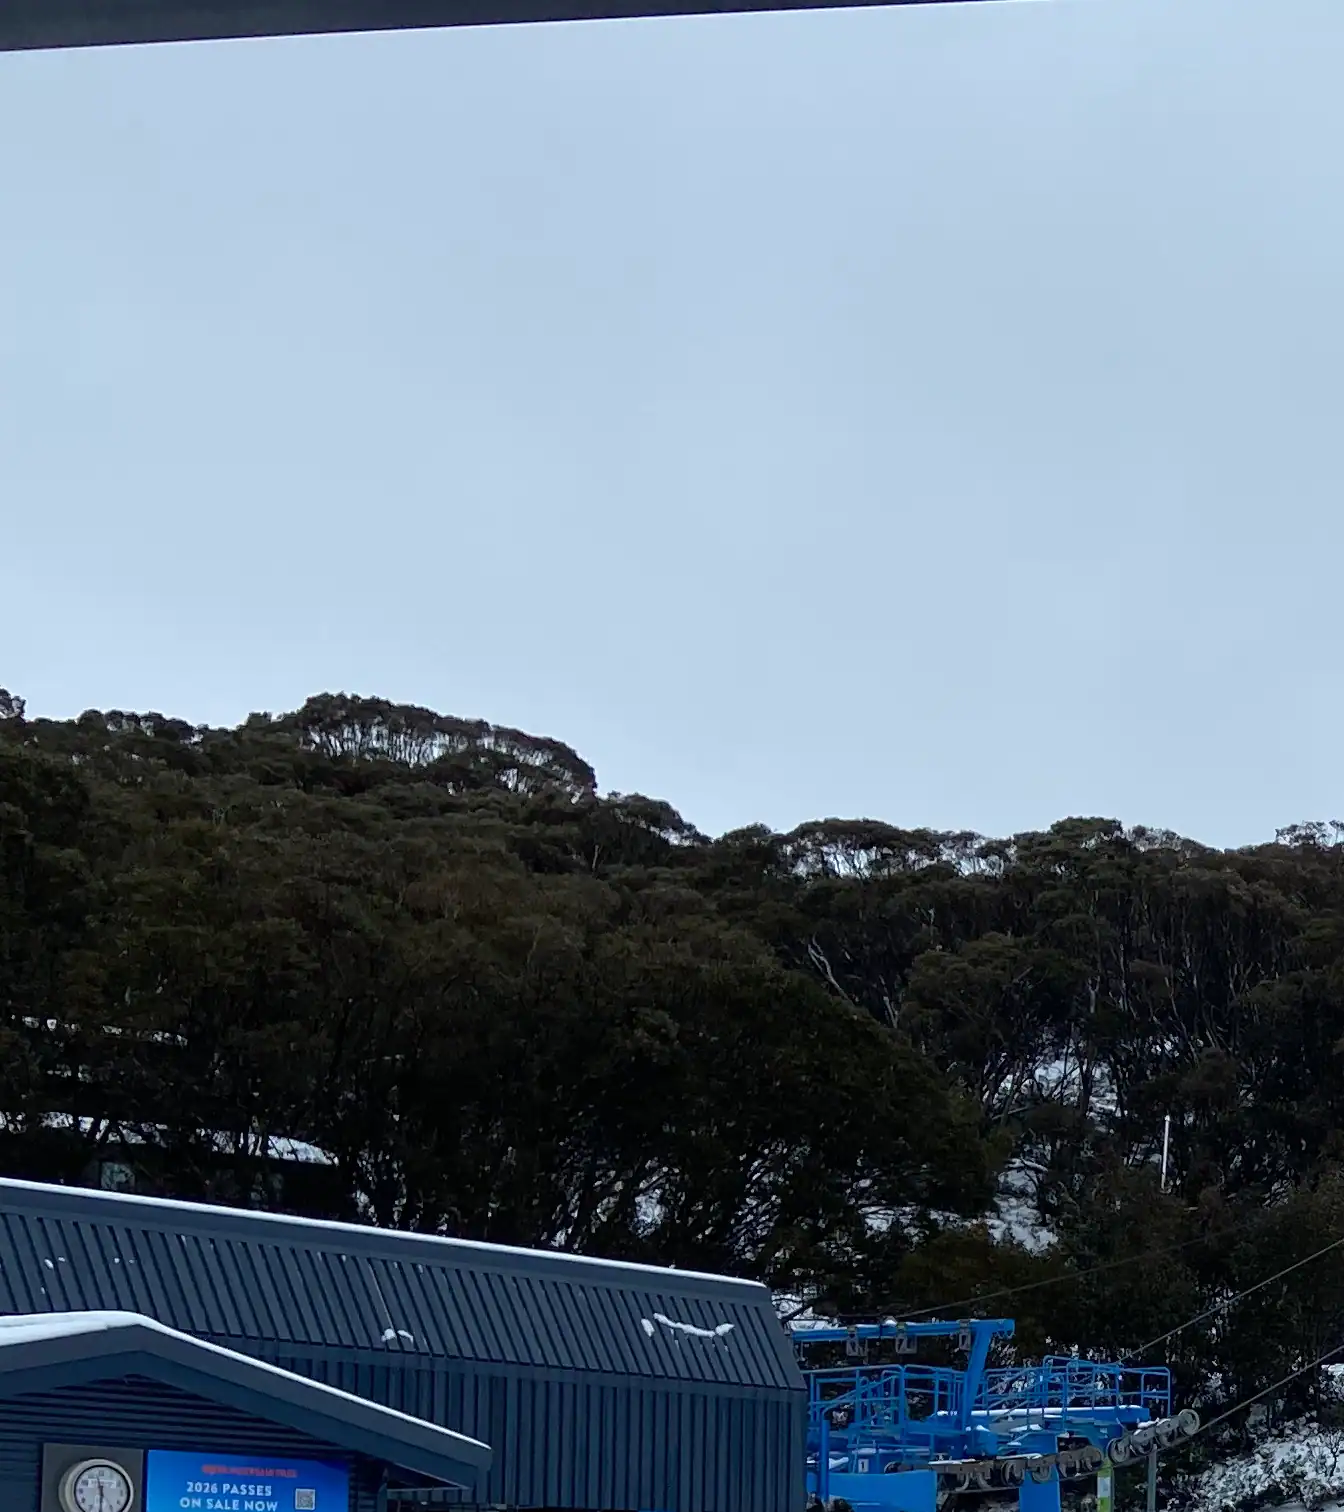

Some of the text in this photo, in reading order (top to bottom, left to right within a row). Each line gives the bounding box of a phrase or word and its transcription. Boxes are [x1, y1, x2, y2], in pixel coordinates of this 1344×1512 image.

[186, 1481, 273, 1497] 2026 PASSES
[179, 1497, 279, 1512] ON SALE NOW
